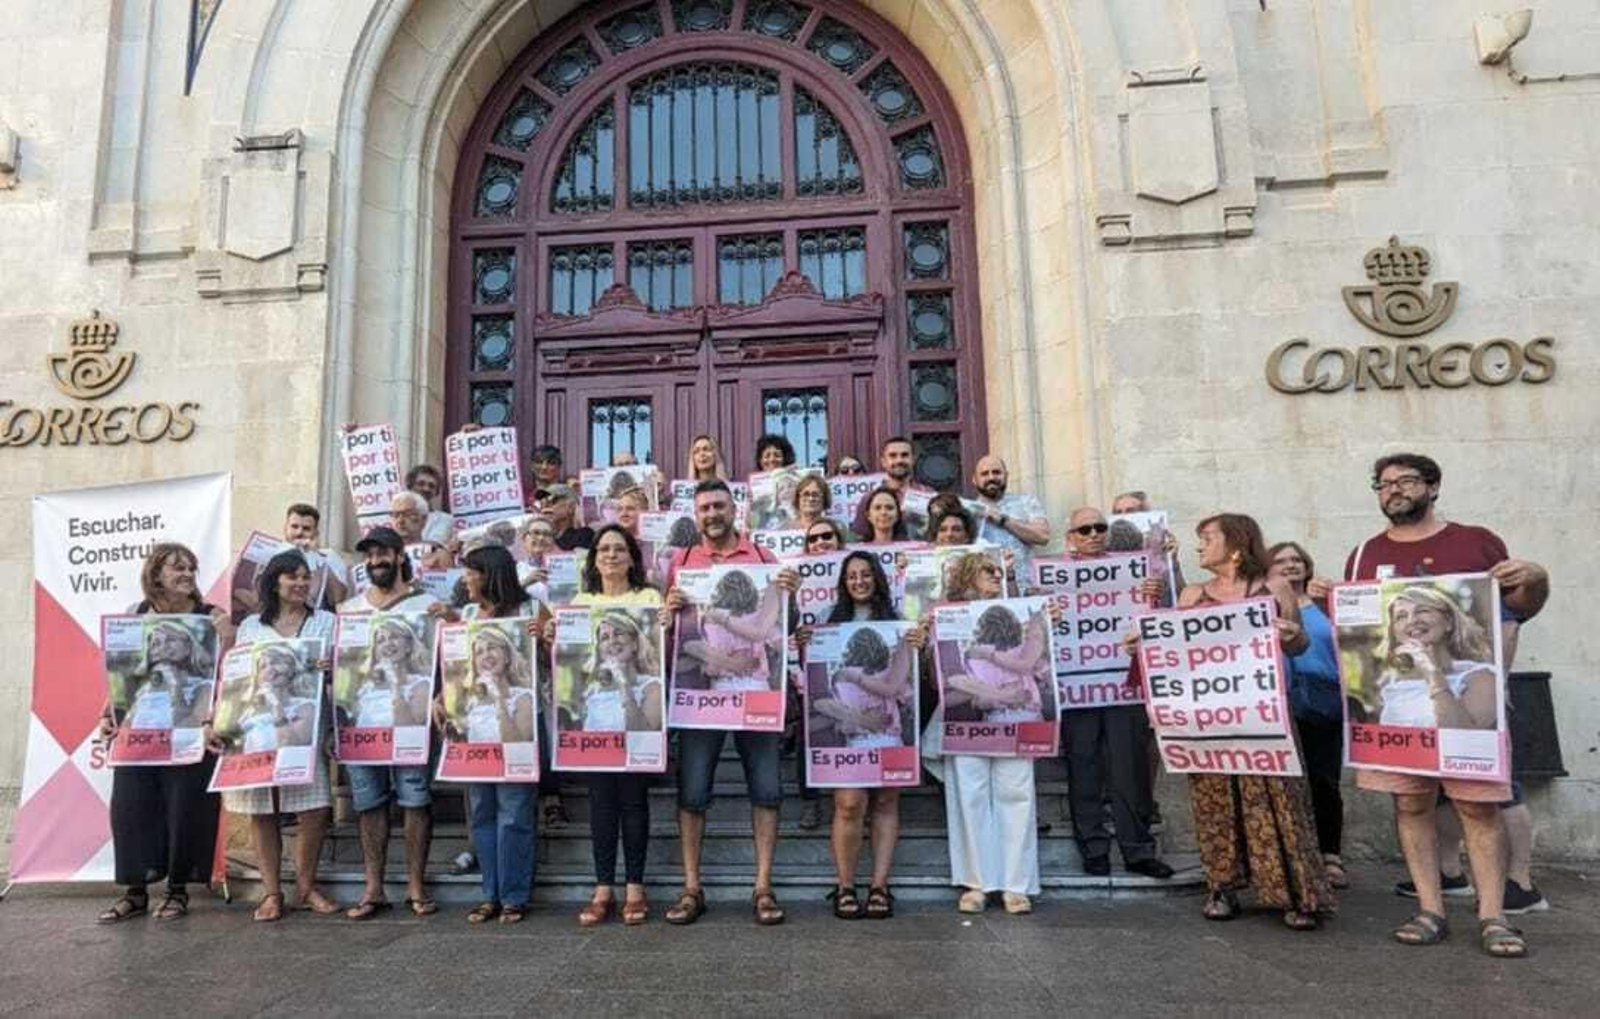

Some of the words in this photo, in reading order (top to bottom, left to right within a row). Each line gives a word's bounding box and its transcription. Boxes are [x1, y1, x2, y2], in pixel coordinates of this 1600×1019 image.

[1265, 337, 1557, 394] CORREOS
[347, 432, 375, 452] por
[449, 437, 463, 451] Es
[468, 434, 495, 452] por
[501, 428, 511, 443] ti
[350, 452, 376, 470] por
[470, 453, 496, 470] por
[352, 472, 380, 491] por
[384, 467, 397, 482] ti
[452, 472, 468, 489] Es
[472, 471, 500, 490] por
[505, 466, 516, 481] ti
[453, 492, 470, 507] Es
[474, 490, 502, 507] por
[69, 511, 165, 538] Escuchar.
[781, 535, 806, 552] po
[70, 570, 118, 593] Vivir.
[1039, 565, 1069, 585] Es
[1076, 565, 1121, 588] por
[1129, 557, 1146, 578] ti
[801, 587, 837, 606] por
[1077, 590, 1121, 613] por
[1078, 616, 1122, 639] por
[1140, 617, 1175, 640] Es
[1183, 613, 1236, 642] por
[1245, 603, 1270, 628] ti
[1080, 642, 1121, 665] por
[1145, 645, 1180, 668] Es
[1188, 644, 1241, 671] por
[1250, 635, 1273, 659] ti
[1149, 675, 1184, 699] Es
[1192, 674, 1245, 701] por
[1253, 665, 1276, 690] ti
[675, 692, 694, 706] Es
[698, 694, 726, 710] por
[732, 693, 744, 708] ti
[1154, 705, 1188, 726] Es
[1195, 706, 1247, 731] por
[1256, 697, 1279, 723] ti
[354, 733, 377, 748] por
[559, 733, 577, 748] Es
[581, 735, 609, 752] por
[946, 723, 964, 736] Es
[969, 726, 997, 740] por
[1003, 723, 1016, 737] ti
[1352, 727, 1372, 743] Es
[1378, 731, 1412, 749] por
[1420, 731, 1436, 748] ti
[811, 750, 831, 765] Es
[835, 752, 863, 769] por
[868, 747, 880, 764] ti
[1164, 744, 1291, 772] Sumar
